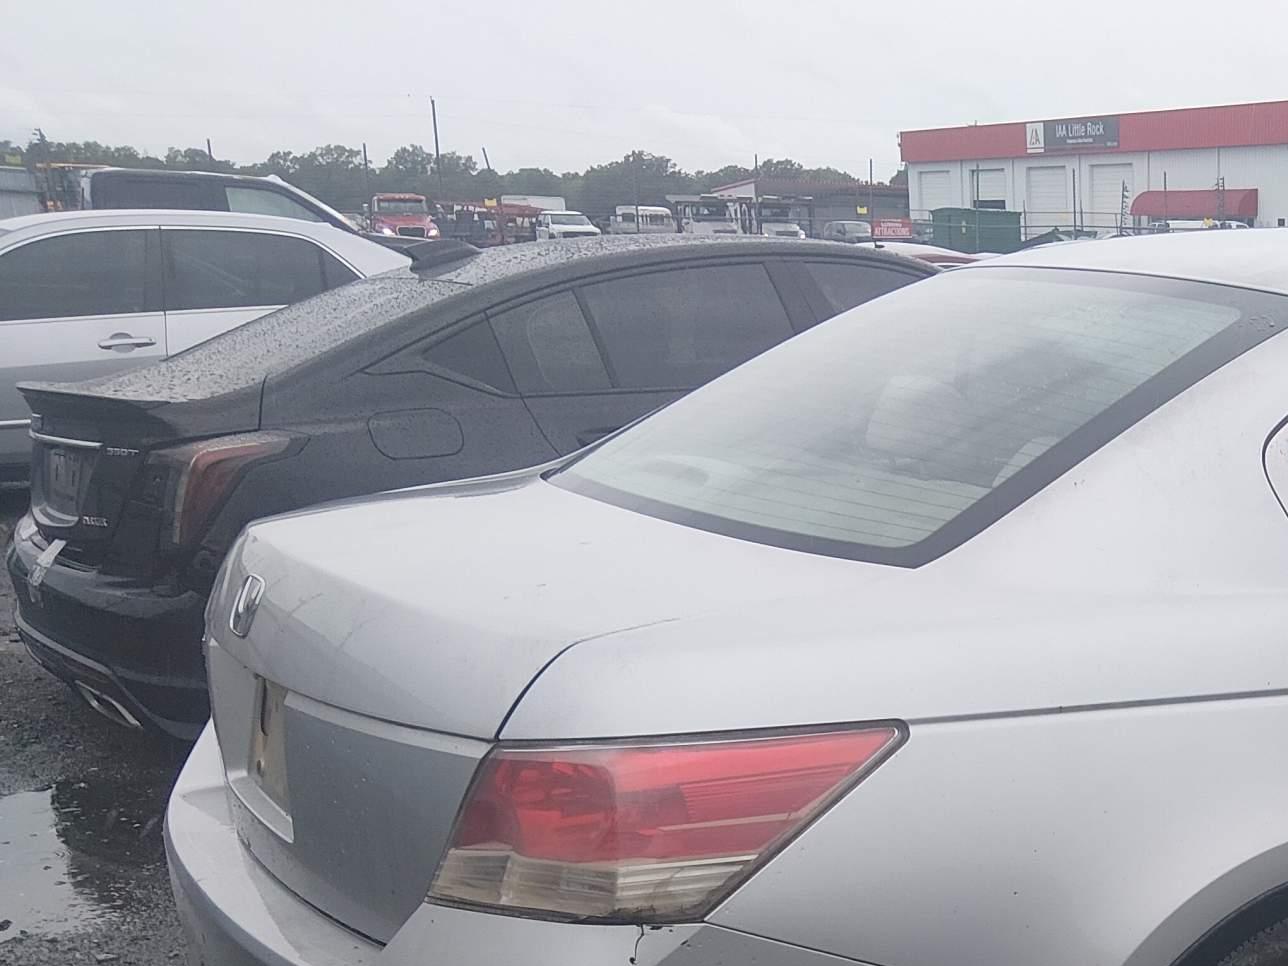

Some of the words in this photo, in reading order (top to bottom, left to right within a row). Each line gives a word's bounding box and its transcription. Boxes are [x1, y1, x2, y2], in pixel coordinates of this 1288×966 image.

[1055, 124, 1067, 137] IAA
[1068, 123, 1086, 137] Little
[1087, 121, 1104, 136] Rock
